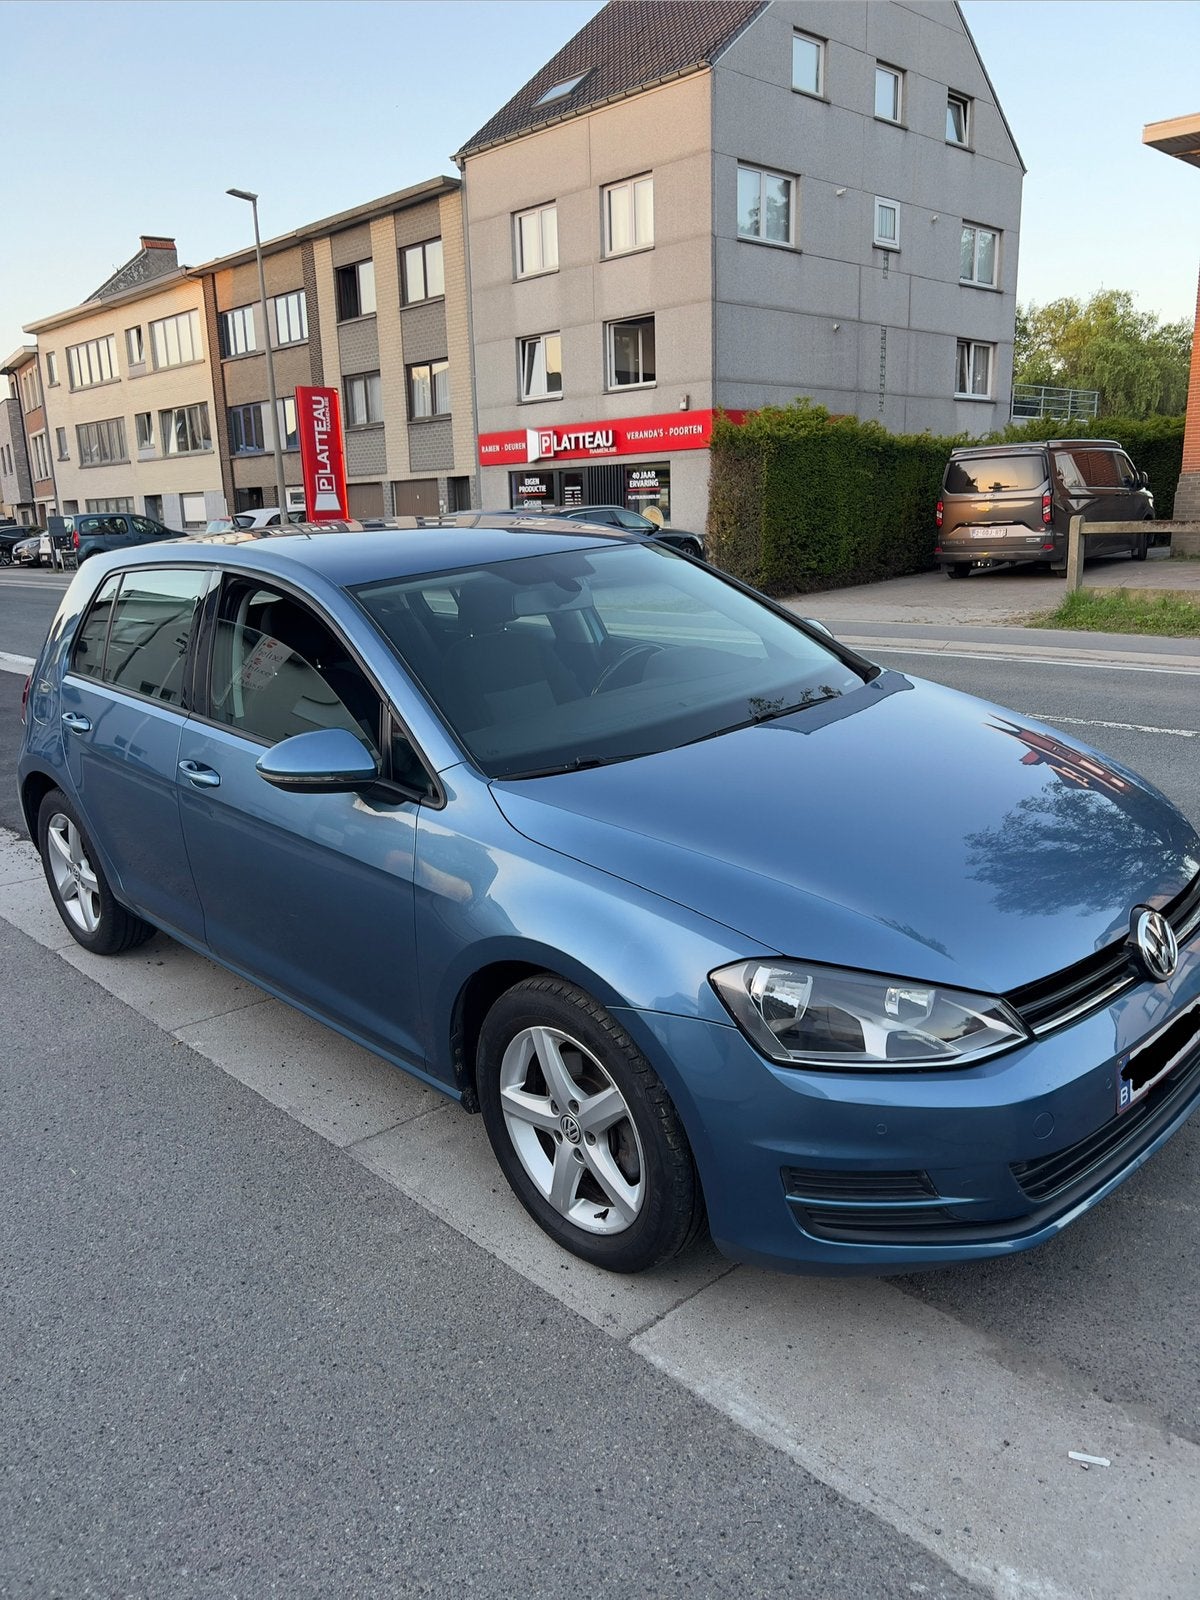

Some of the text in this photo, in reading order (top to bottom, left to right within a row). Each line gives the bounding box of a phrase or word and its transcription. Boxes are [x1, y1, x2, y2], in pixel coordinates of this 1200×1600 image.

[626, 428, 664, 440] VERANDA'S
[669, 424, 703, 436] POORTEN
[312, 396, 332, 490] PLATTEAU
[541, 430, 613, 452] PLATTEAU
[482, 445, 500, 453] RAMEN
[504, 443, 526, 452] DEUREN
[632, 470, 656, 479] 40 JAAR
[524, 478, 540, 486] EIGEN
[629, 478, 659, 488] ERVARING
[519, 485, 547, 493] PRODUCTIE
[1120, 1086, 1129, 1106] B
